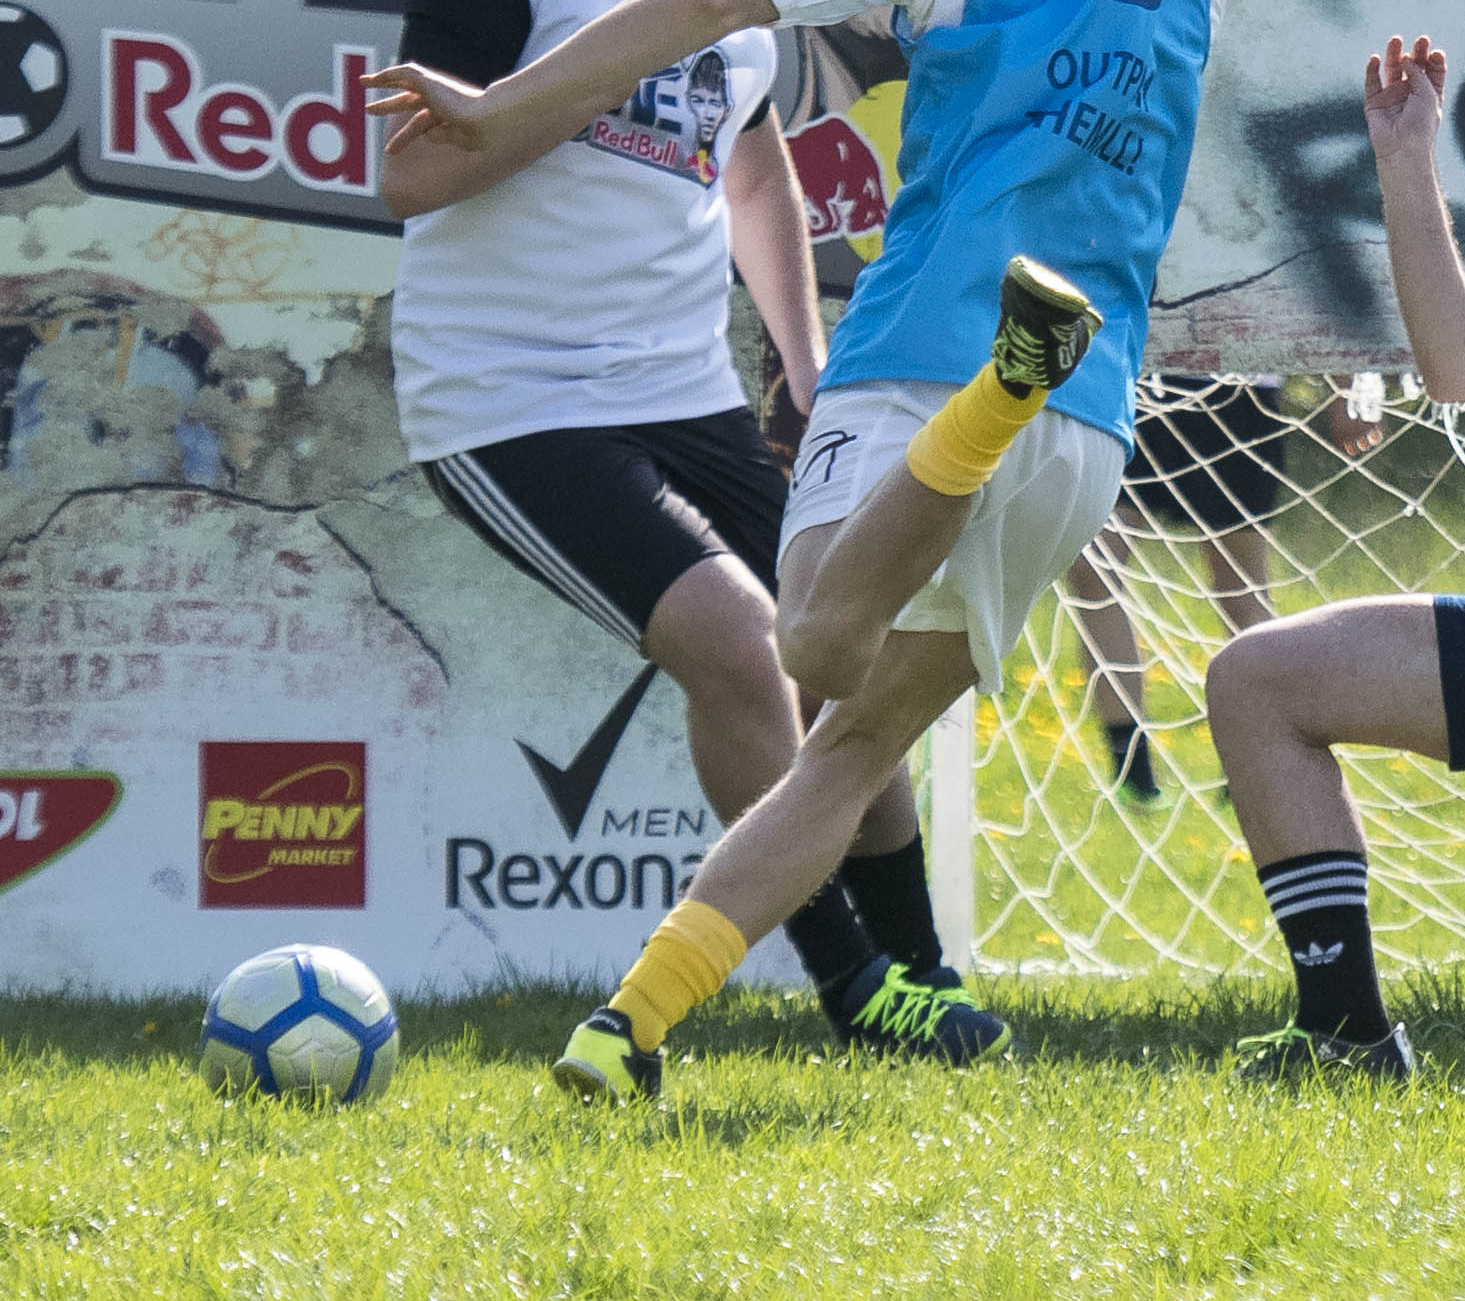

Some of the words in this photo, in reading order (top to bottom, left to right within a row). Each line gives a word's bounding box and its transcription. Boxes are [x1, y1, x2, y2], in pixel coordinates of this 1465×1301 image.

[109, 38, 366, 186] Red
[594, 121, 635, 153] Red
[637, 135, 678, 166] Bull
[202, 799, 363, 840] PENNY
[602, 809, 705, 837] MEN
[268, 849, 356, 865] MARKET
